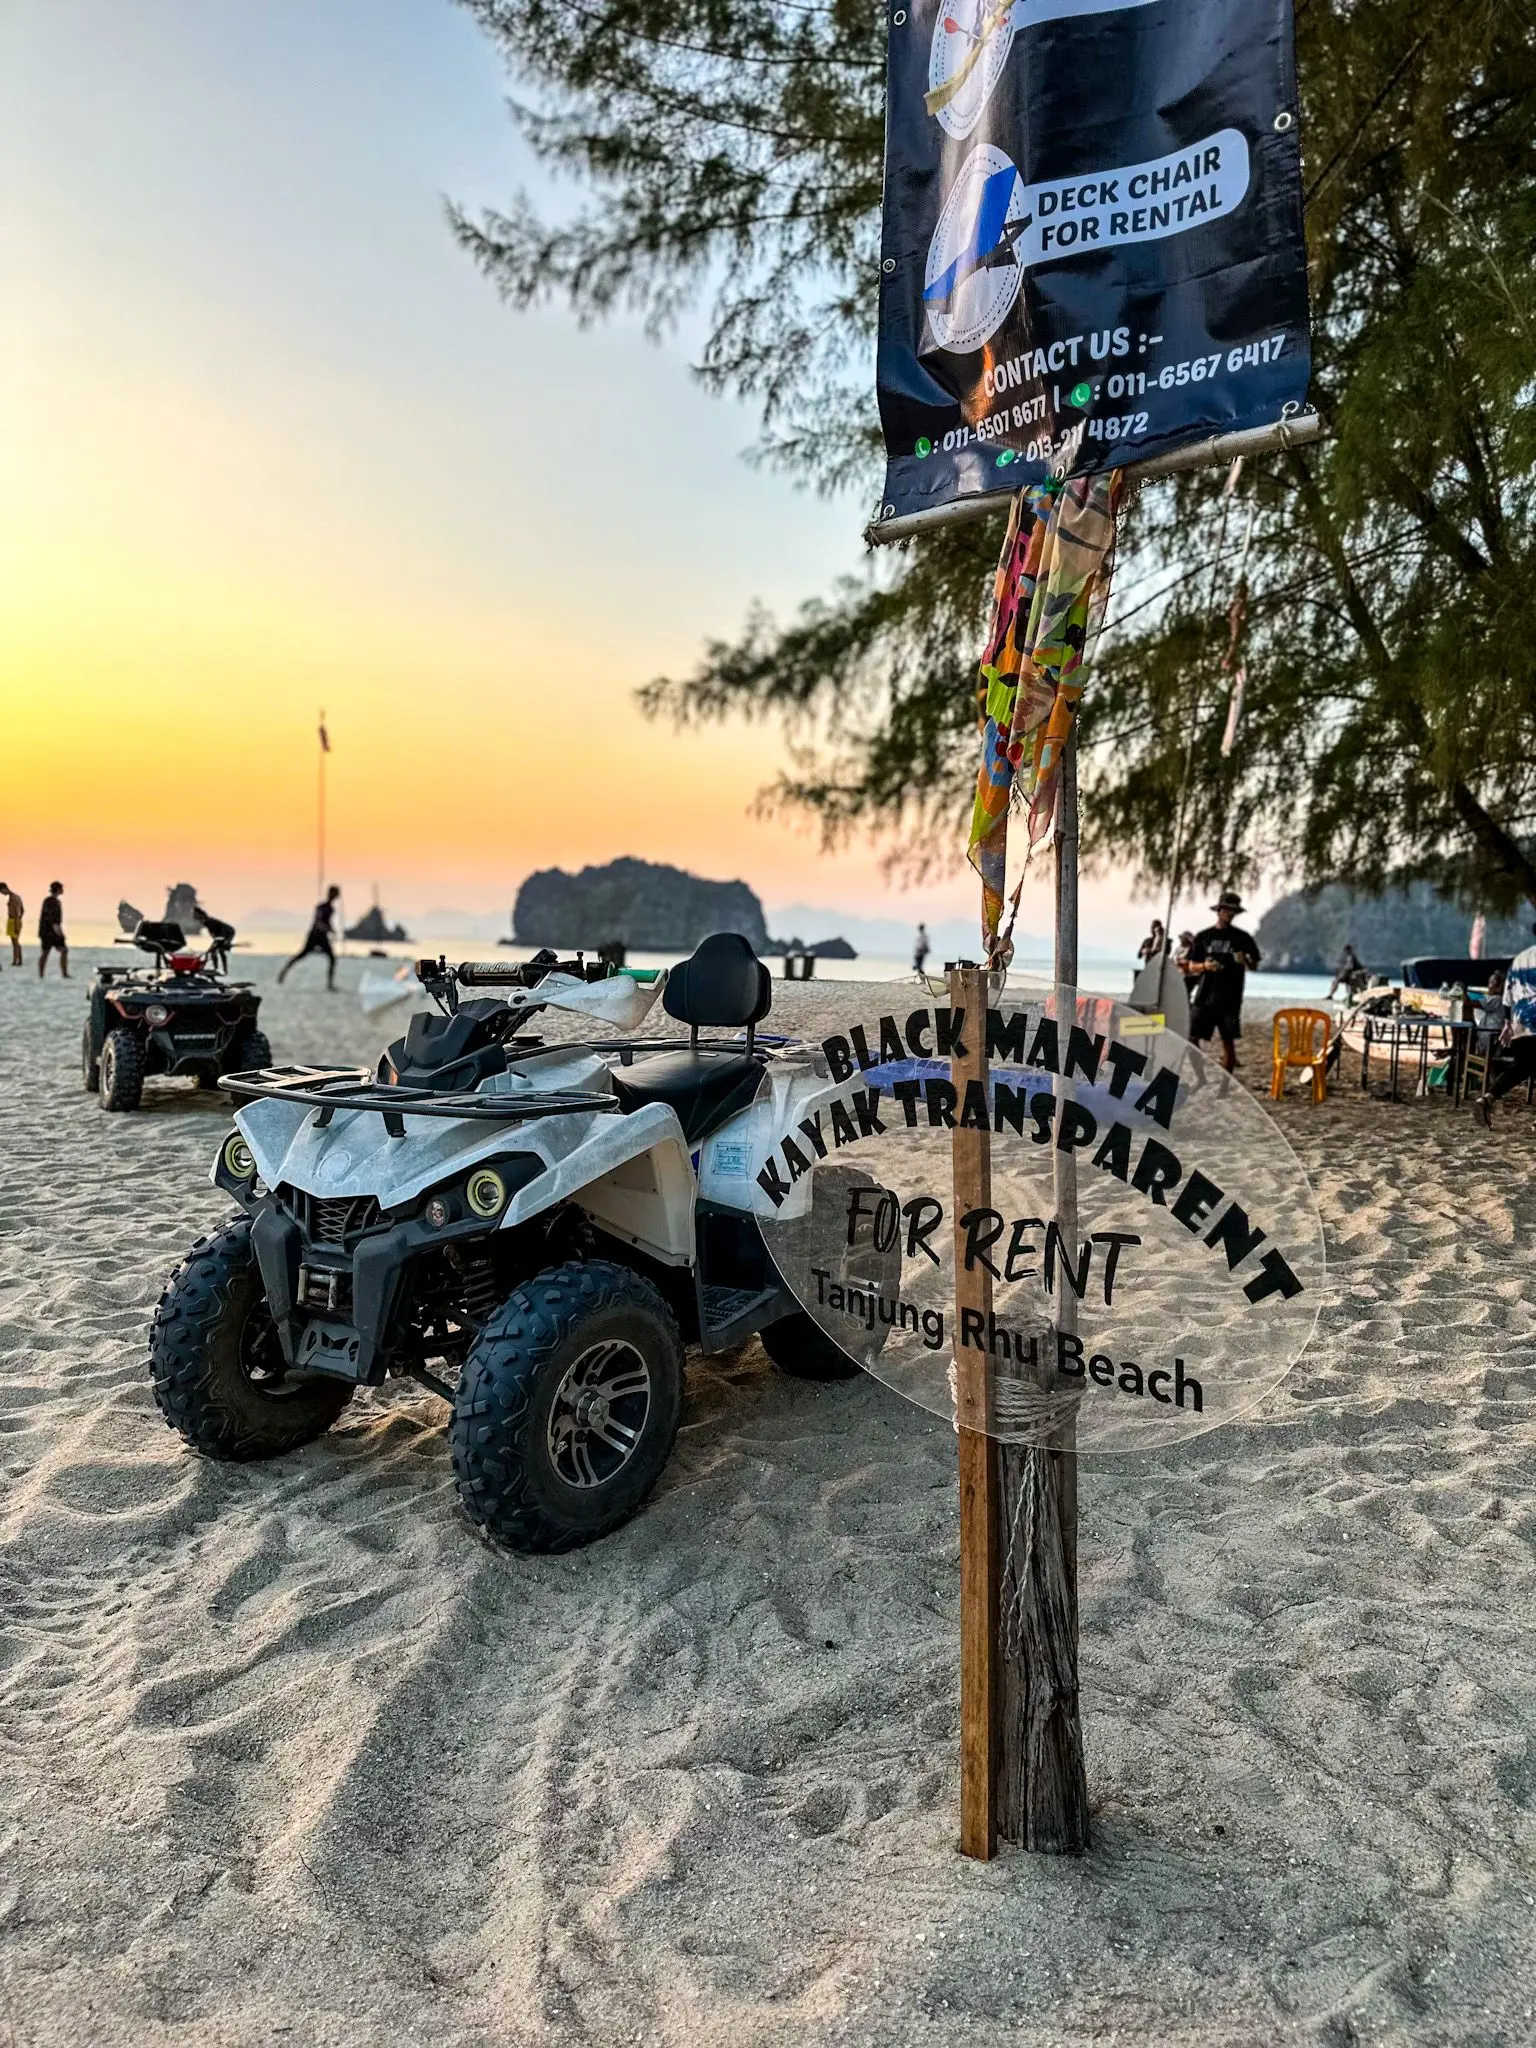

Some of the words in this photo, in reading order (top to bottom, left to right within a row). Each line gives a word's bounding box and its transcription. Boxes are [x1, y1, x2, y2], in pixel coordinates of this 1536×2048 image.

[1038, 179, 1119, 217] DECK
[1128, 146, 1221, 200] CHAIR
[1041, 216, 1100, 251] FOR
[1109, 183, 1222, 236] RENTAL
[983, 335, 1083, 399] CONTACT
[1089, 326, 1130, 358] US
[1012, 394, 1046, 428] 8677
[1107, 355, 1220, 399] 011-6567
[1226, 334, 1286, 374] 6417
[1087, 410, 1147, 444] 4872
[821, 1007, 970, 1085] BLACK
[985, 1008, 1180, 1131] MANTA
[755, 1087, 888, 1209] KAYAK
[892, 1077, 1305, 1305] TRANSPARENT
[845, 1186, 943, 1267] FOR
[959, 1207, 1142, 1306] RENT
[811, 1267, 944, 1351] Tanjung
[960, 1305, 1038, 1367] Rhu
[1056, 1331, 1203, 1413] Beach
